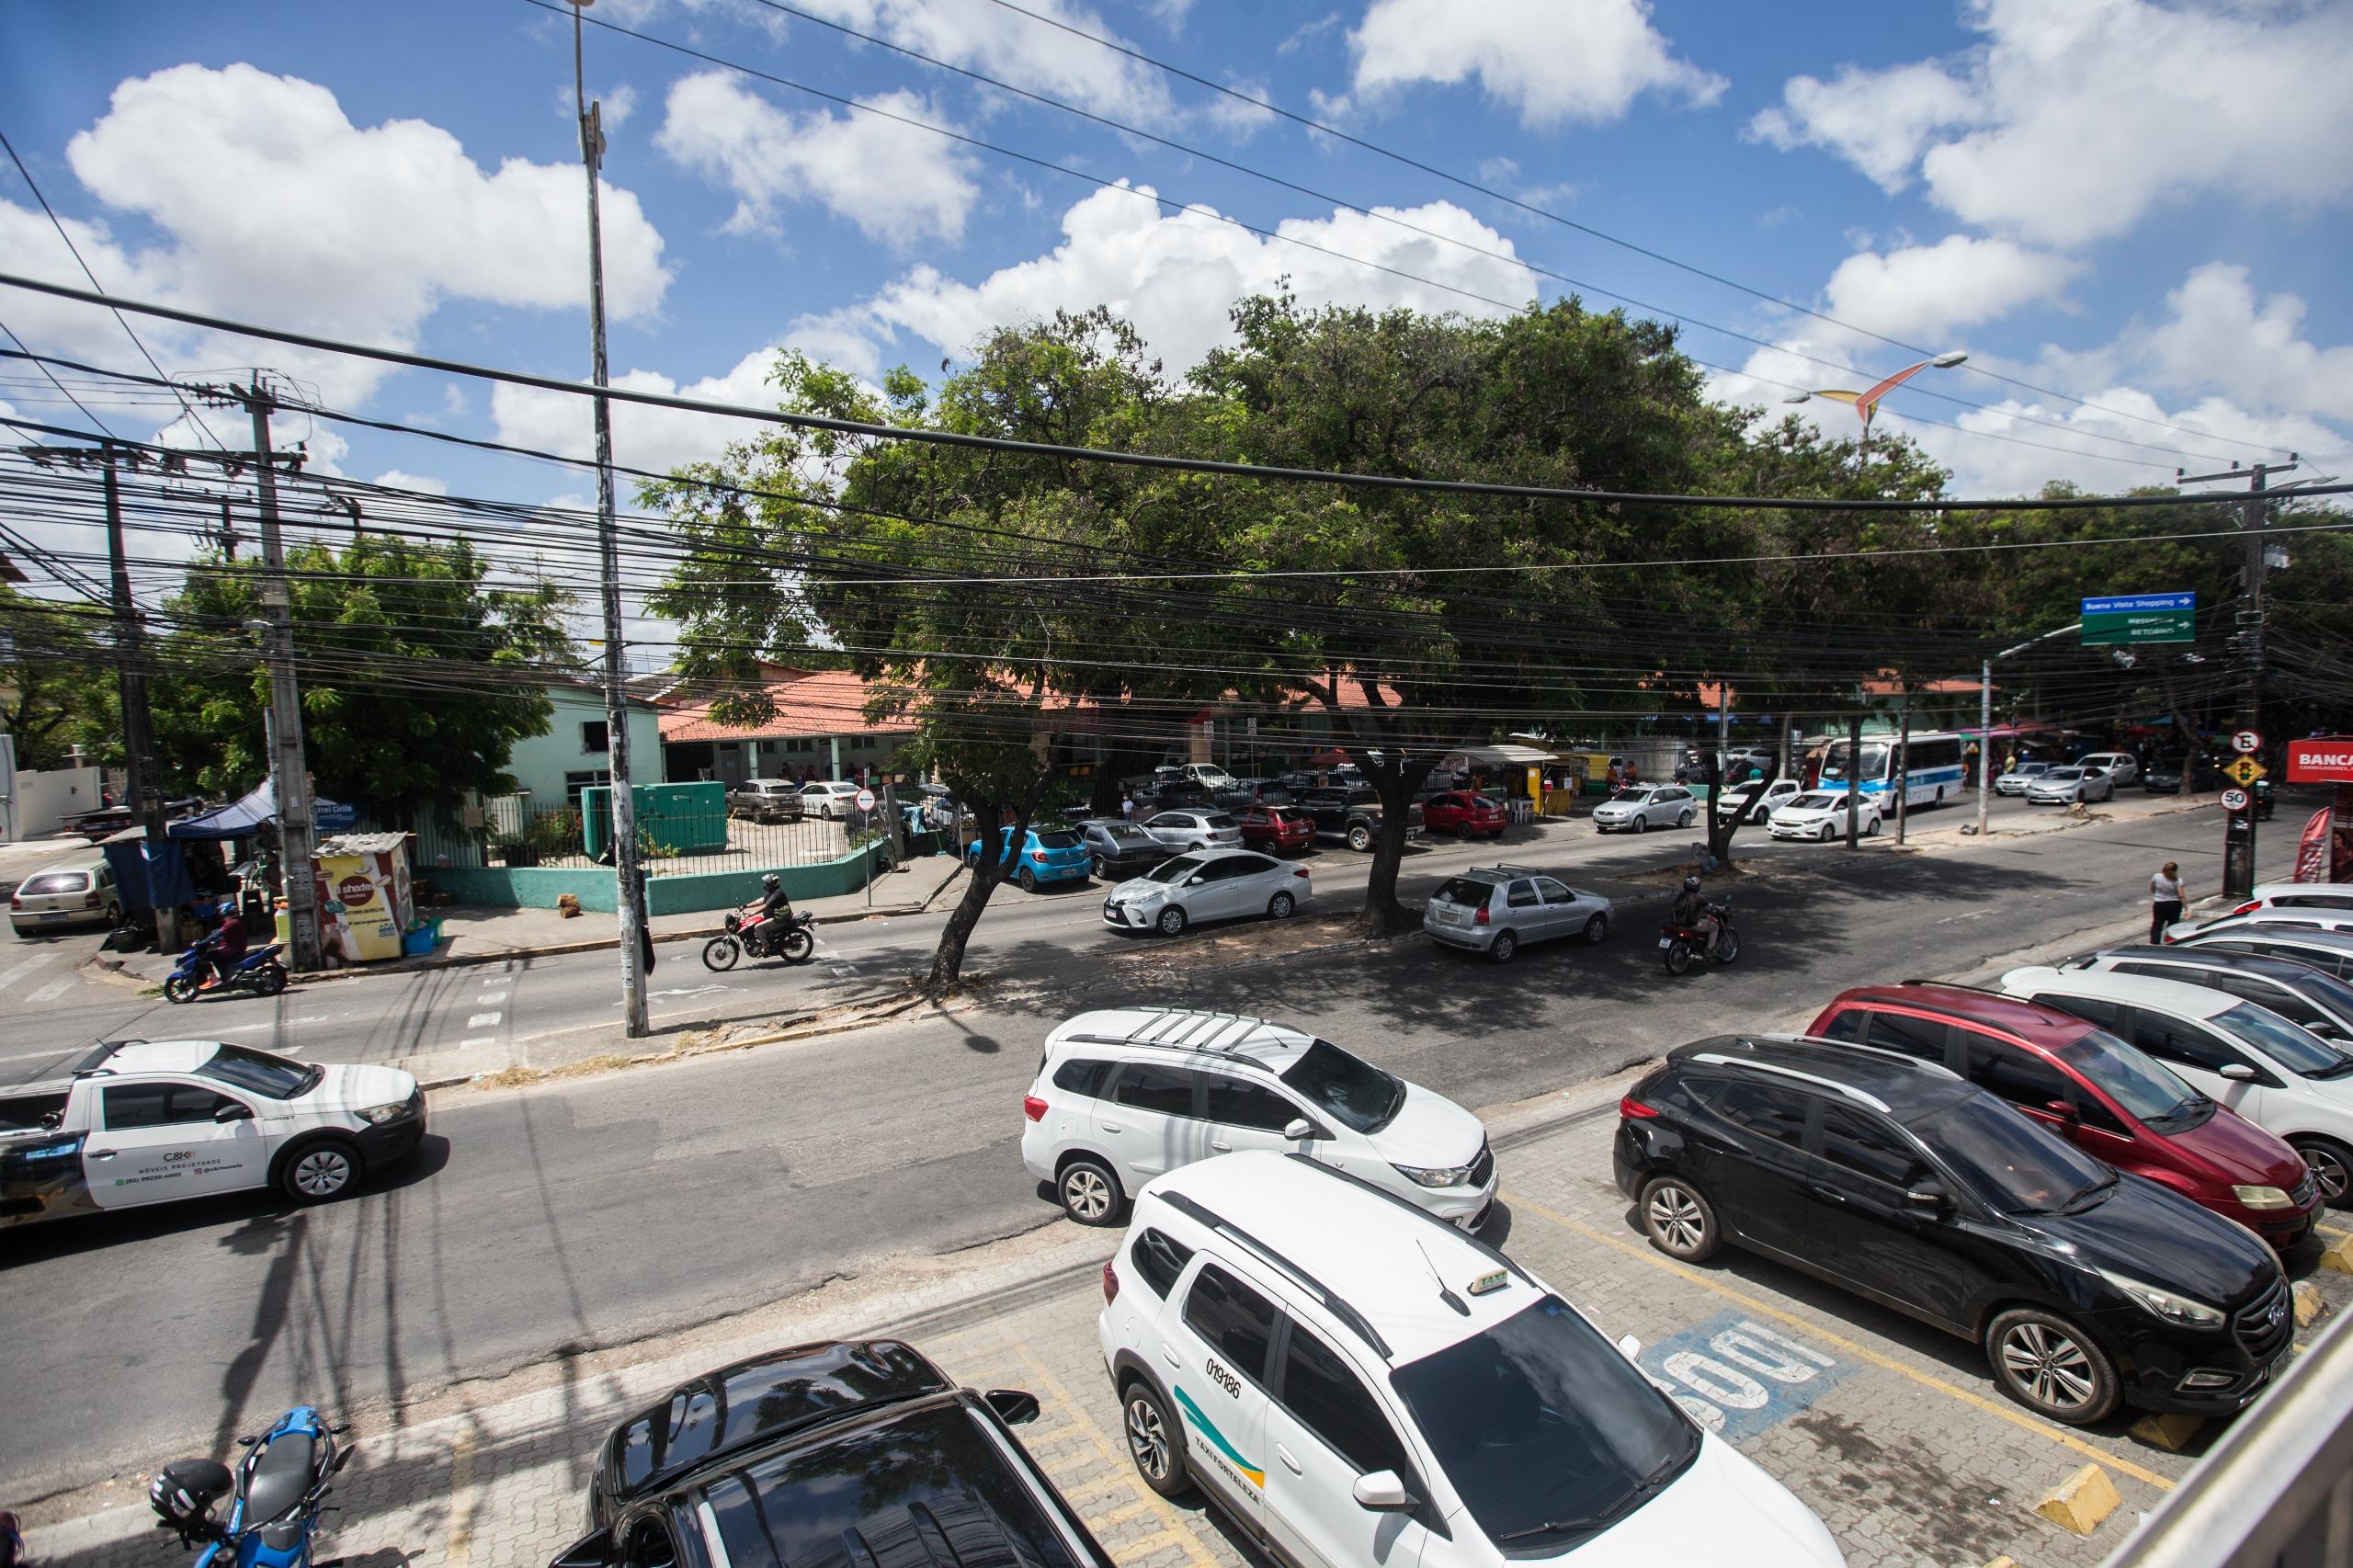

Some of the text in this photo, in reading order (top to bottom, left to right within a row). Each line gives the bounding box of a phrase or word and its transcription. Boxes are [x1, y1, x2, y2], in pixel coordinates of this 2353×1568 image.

[2135, 599, 2175, 608] Shopping
[2224, 792, 2245, 803] 50
[1206, 1358, 1242, 1399] 019186
[1195, 1436, 1260, 1506] TAXI FORTALEZA
